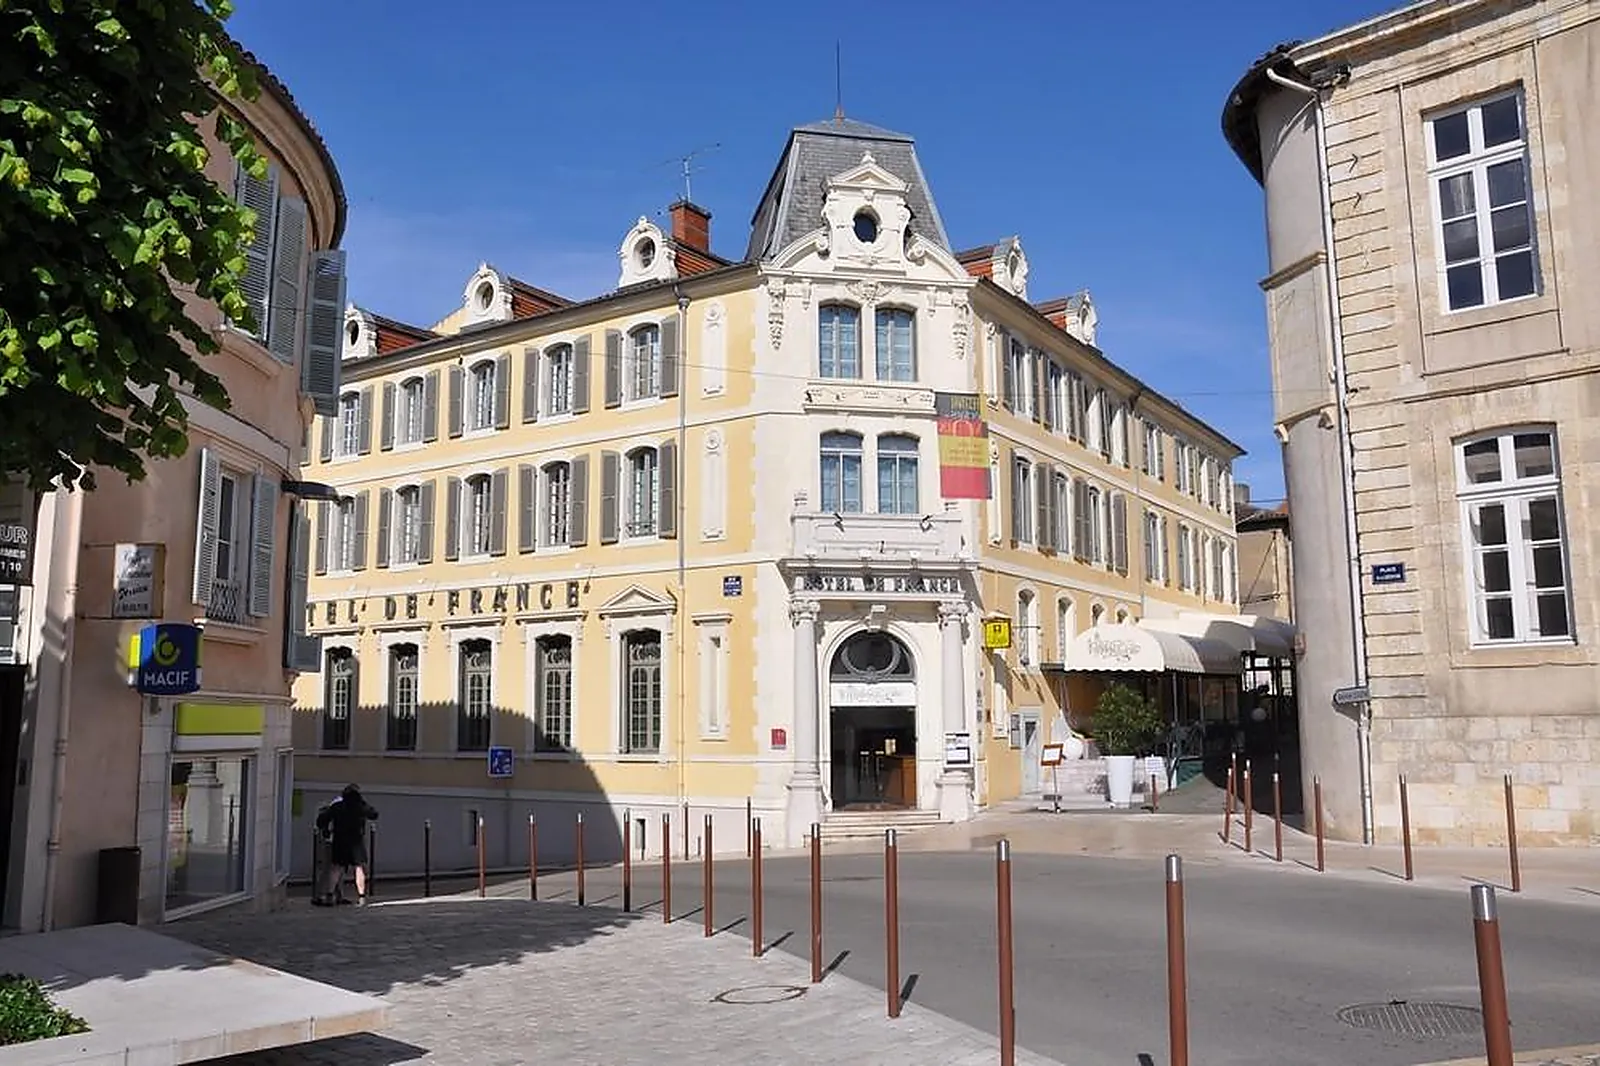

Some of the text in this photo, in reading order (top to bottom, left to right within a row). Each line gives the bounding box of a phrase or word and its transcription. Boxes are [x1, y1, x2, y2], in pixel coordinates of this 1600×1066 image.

[385, 594, 417, 620] DE
[448, 582, 579, 615] FRANCE
[143, 671, 190, 686] MACIF
